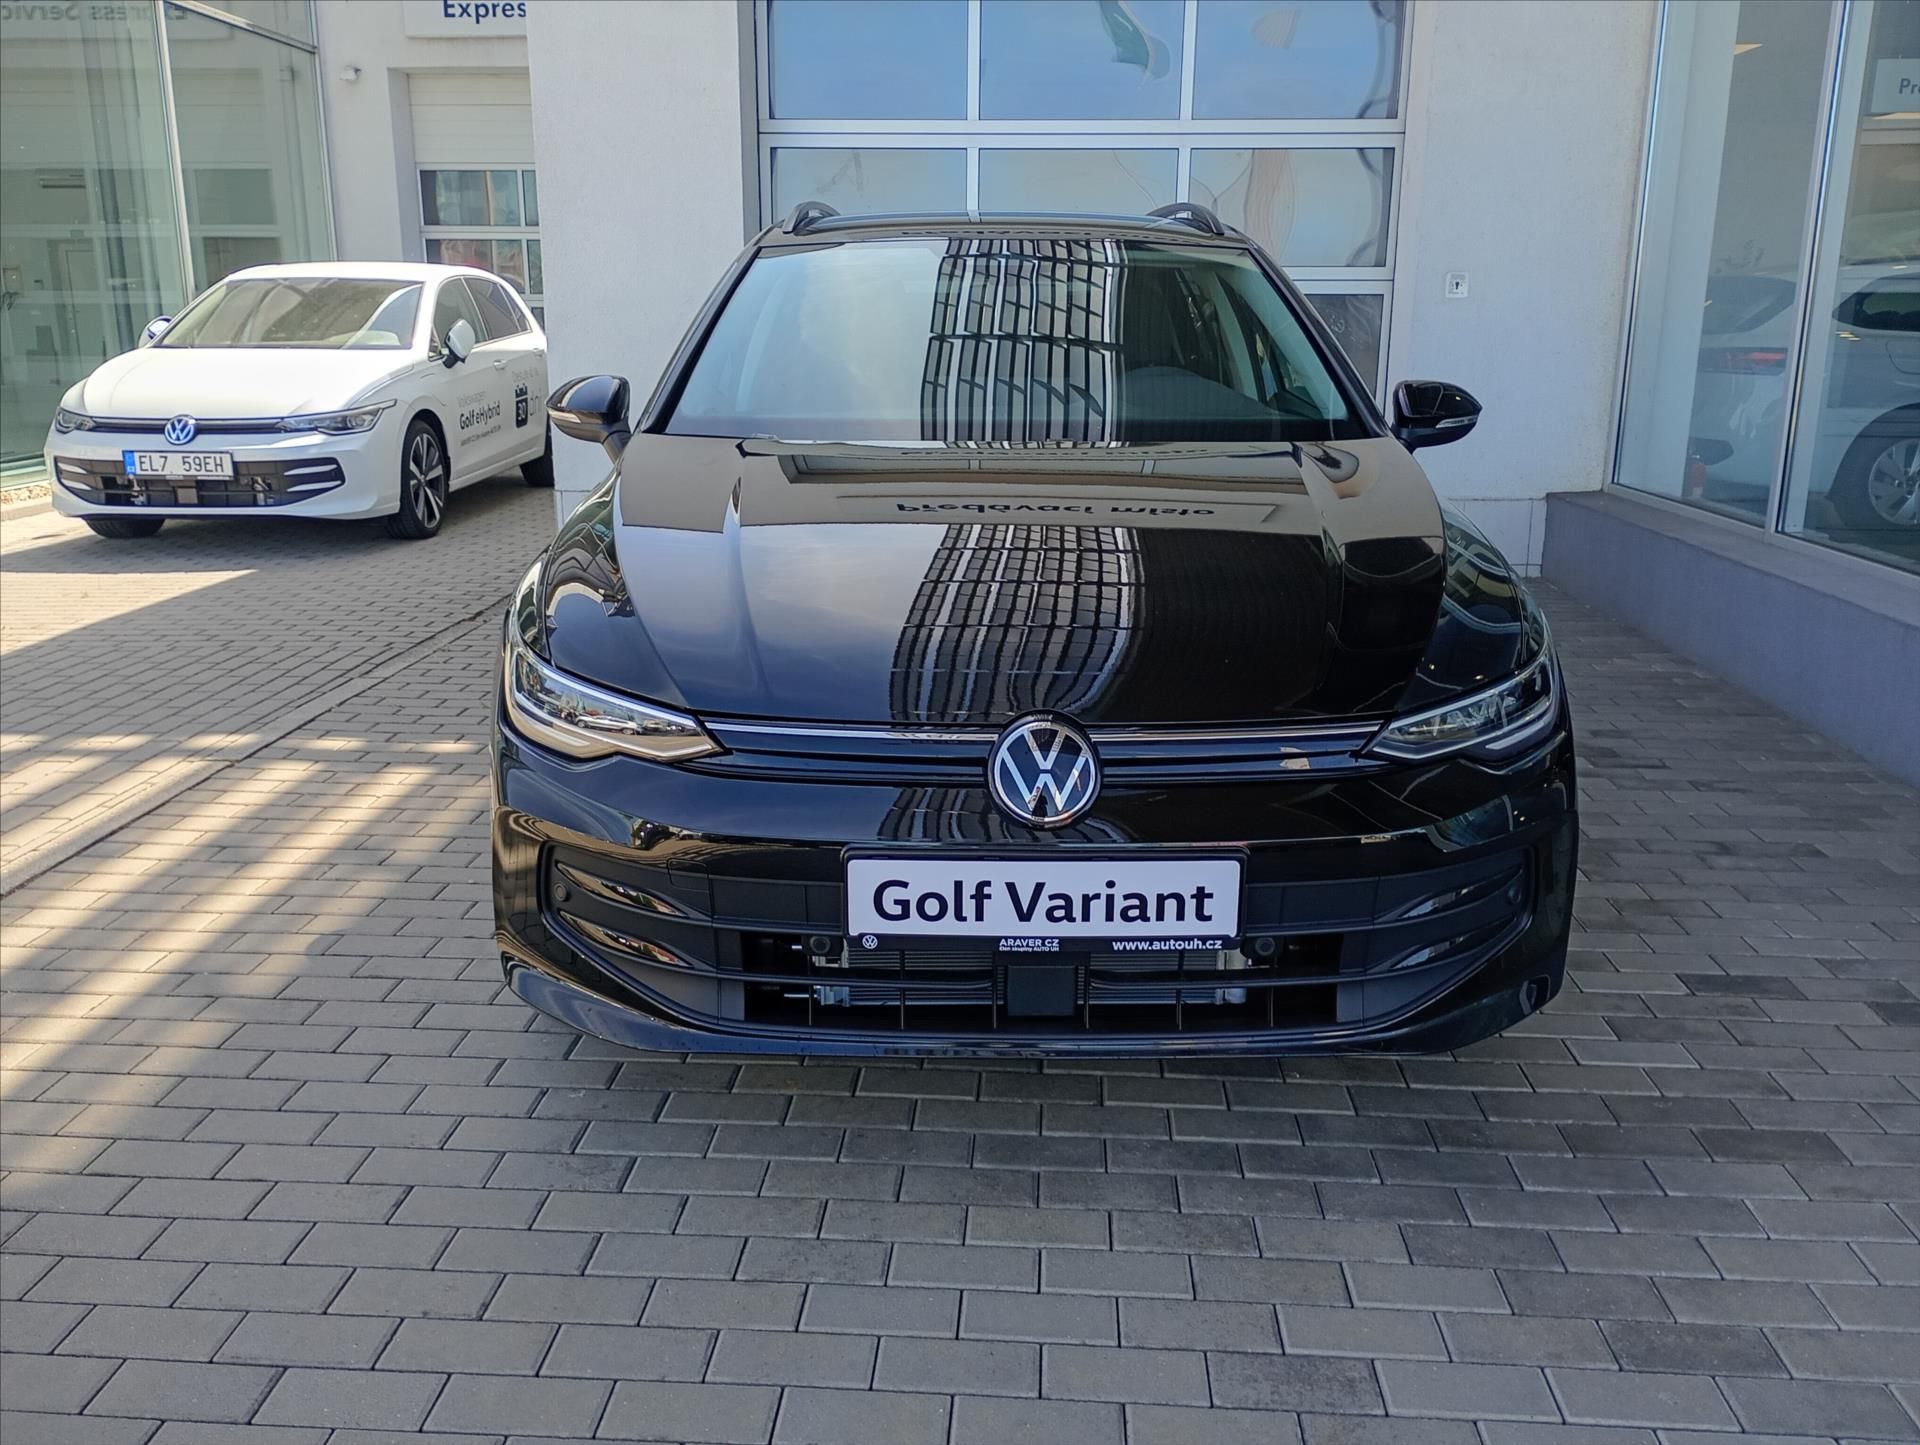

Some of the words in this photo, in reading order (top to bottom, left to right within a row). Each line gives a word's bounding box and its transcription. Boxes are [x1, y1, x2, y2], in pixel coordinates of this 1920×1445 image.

[443, 0, 527, 24] Expres
[1899, 77, 1920, 95] Pr
[138, 455, 168, 472] EL7
[181, 456, 225, 473] 59EH
[872, 879, 993, 922] Golf
[1004, 879, 1215, 924] Variant
[1000, 938, 1042, 947] ARAVER
[1045, 938, 1060, 947] CZ
[1112, 938, 1223, 951] www.autouh.cz
